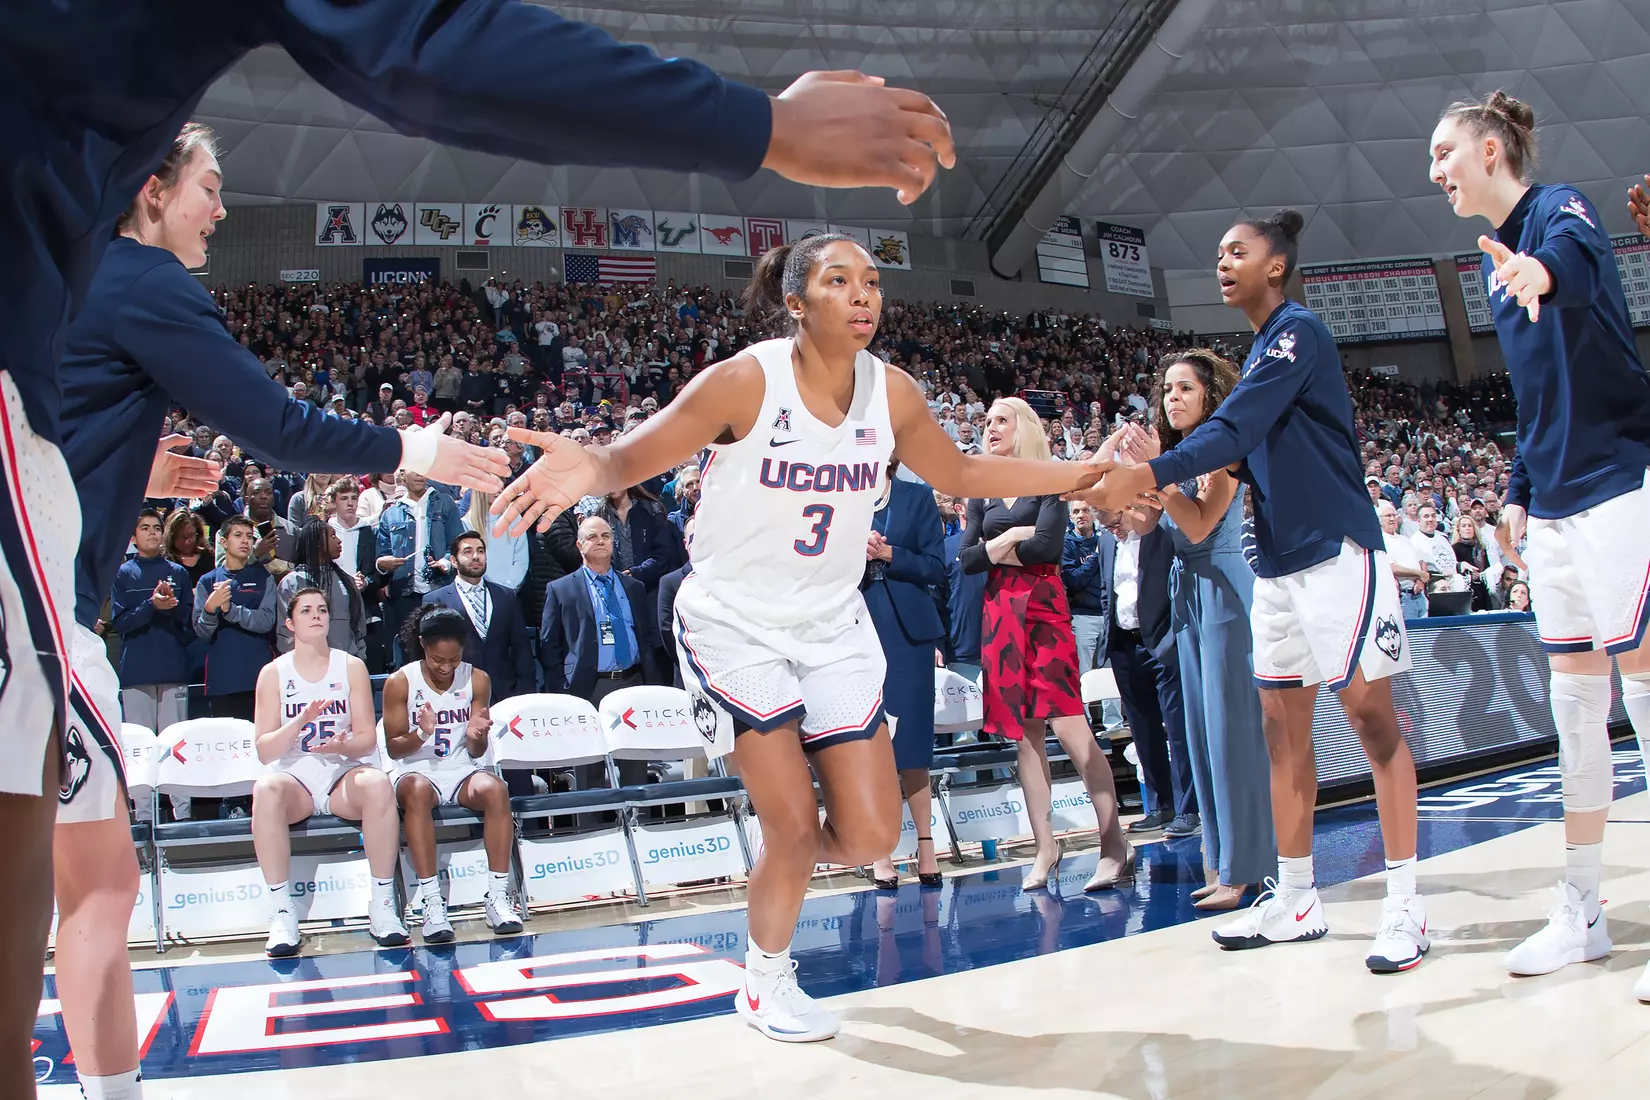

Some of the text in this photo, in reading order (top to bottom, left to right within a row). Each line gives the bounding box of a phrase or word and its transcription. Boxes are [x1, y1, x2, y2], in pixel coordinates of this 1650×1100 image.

[419, 208, 461, 240] UCF
[1111, 226, 1131, 234] COACH
[1113, 234, 1142, 243] CALHOUN
[1611, 237, 1638, 247] NCAA
[1109, 242, 1140, 262] 873
[1613, 245, 1650, 254] OURNAM
[1336, 264, 1366, 272] AMERICAN
[1395, 260, 1431, 268] CONFERENCE
[296, 271, 318, 280] 220
[371, 271, 432, 284] UCONN
[1305, 269, 1432, 283] REGULAR SEASON CHAMPIONS
[1471, 325, 1495, 333] CONNE
[759, 457, 879, 492] UCONN
[794, 504, 835, 557] 3
[935, 685, 977, 696] ICKE
[935, 695, 979, 705] GALAX
[646, 719, 687, 728] GALA
[301, 721, 336, 752] 25
[434, 728, 451, 758] 5
[195, 740, 251, 752] TICKE
[196, 751, 251, 762] GALAX
[956, 800, 1022, 825] genius3D
[644, 836, 731, 864] genius3D
[529, 850, 620, 879] genius3D
[290, 873, 368, 897] genius3
[168, 883, 262, 909] genius3D
